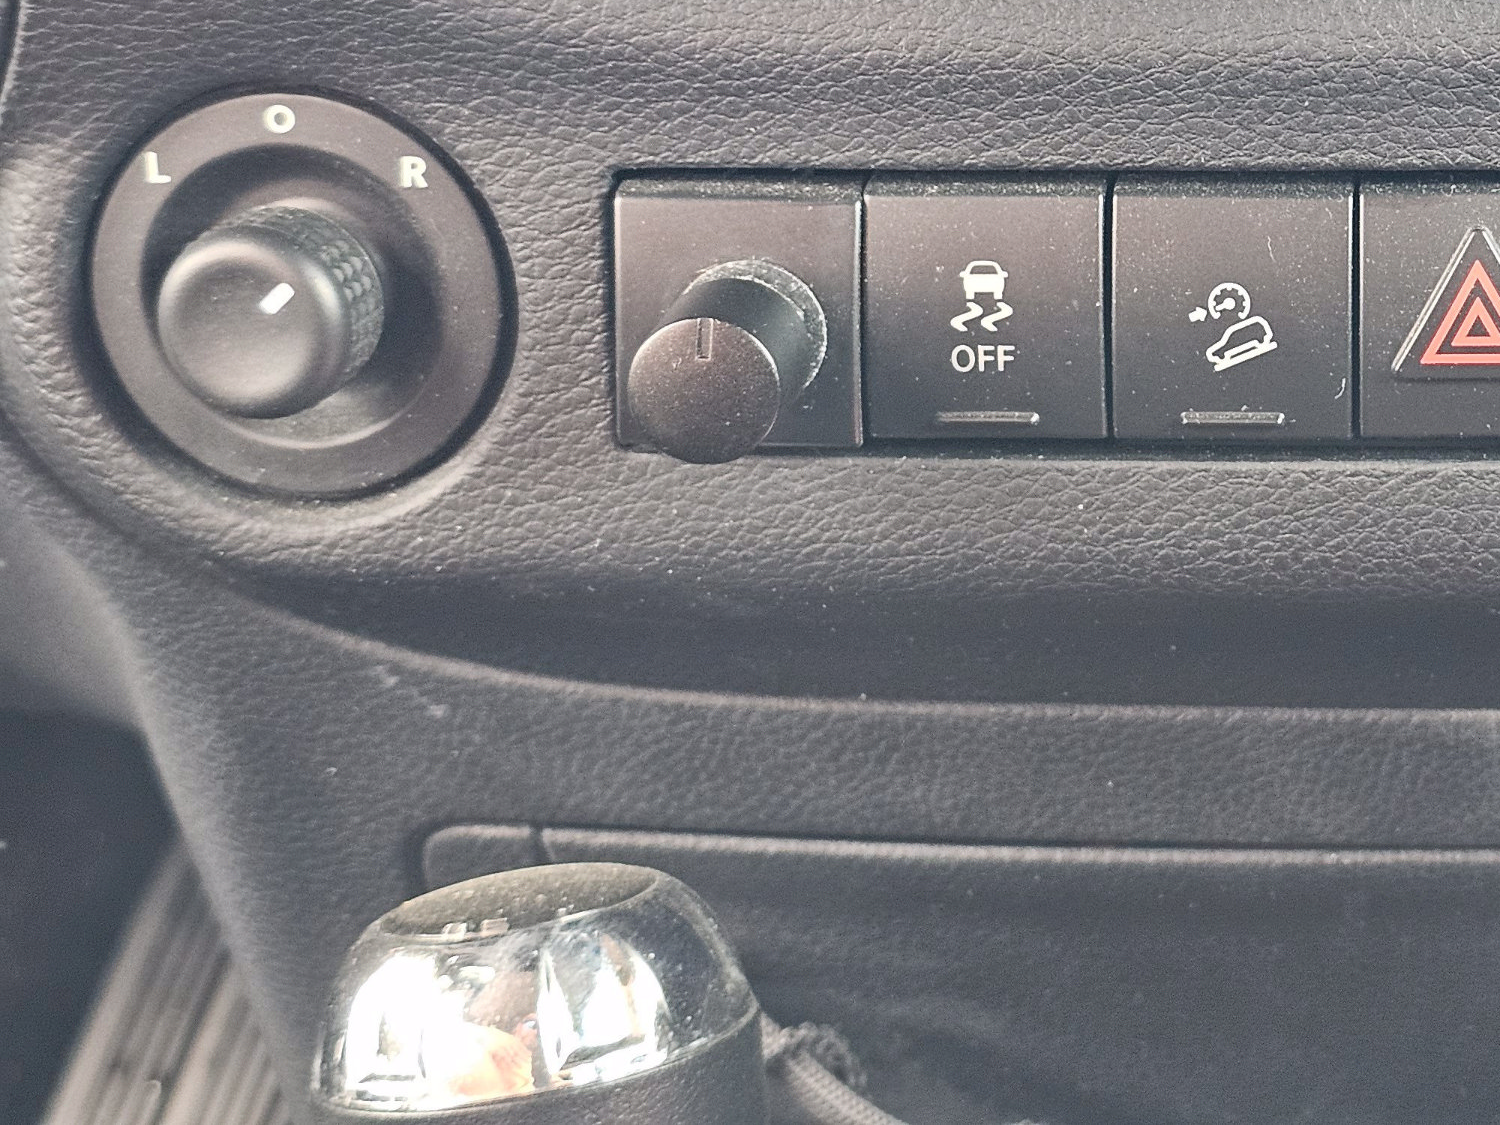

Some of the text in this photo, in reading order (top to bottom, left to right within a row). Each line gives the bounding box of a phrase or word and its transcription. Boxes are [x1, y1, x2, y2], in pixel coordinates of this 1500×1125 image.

[143, 151, 172, 184] L
[399, 155, 429, 189] R
[949, 344, 1016, 373] OFF
